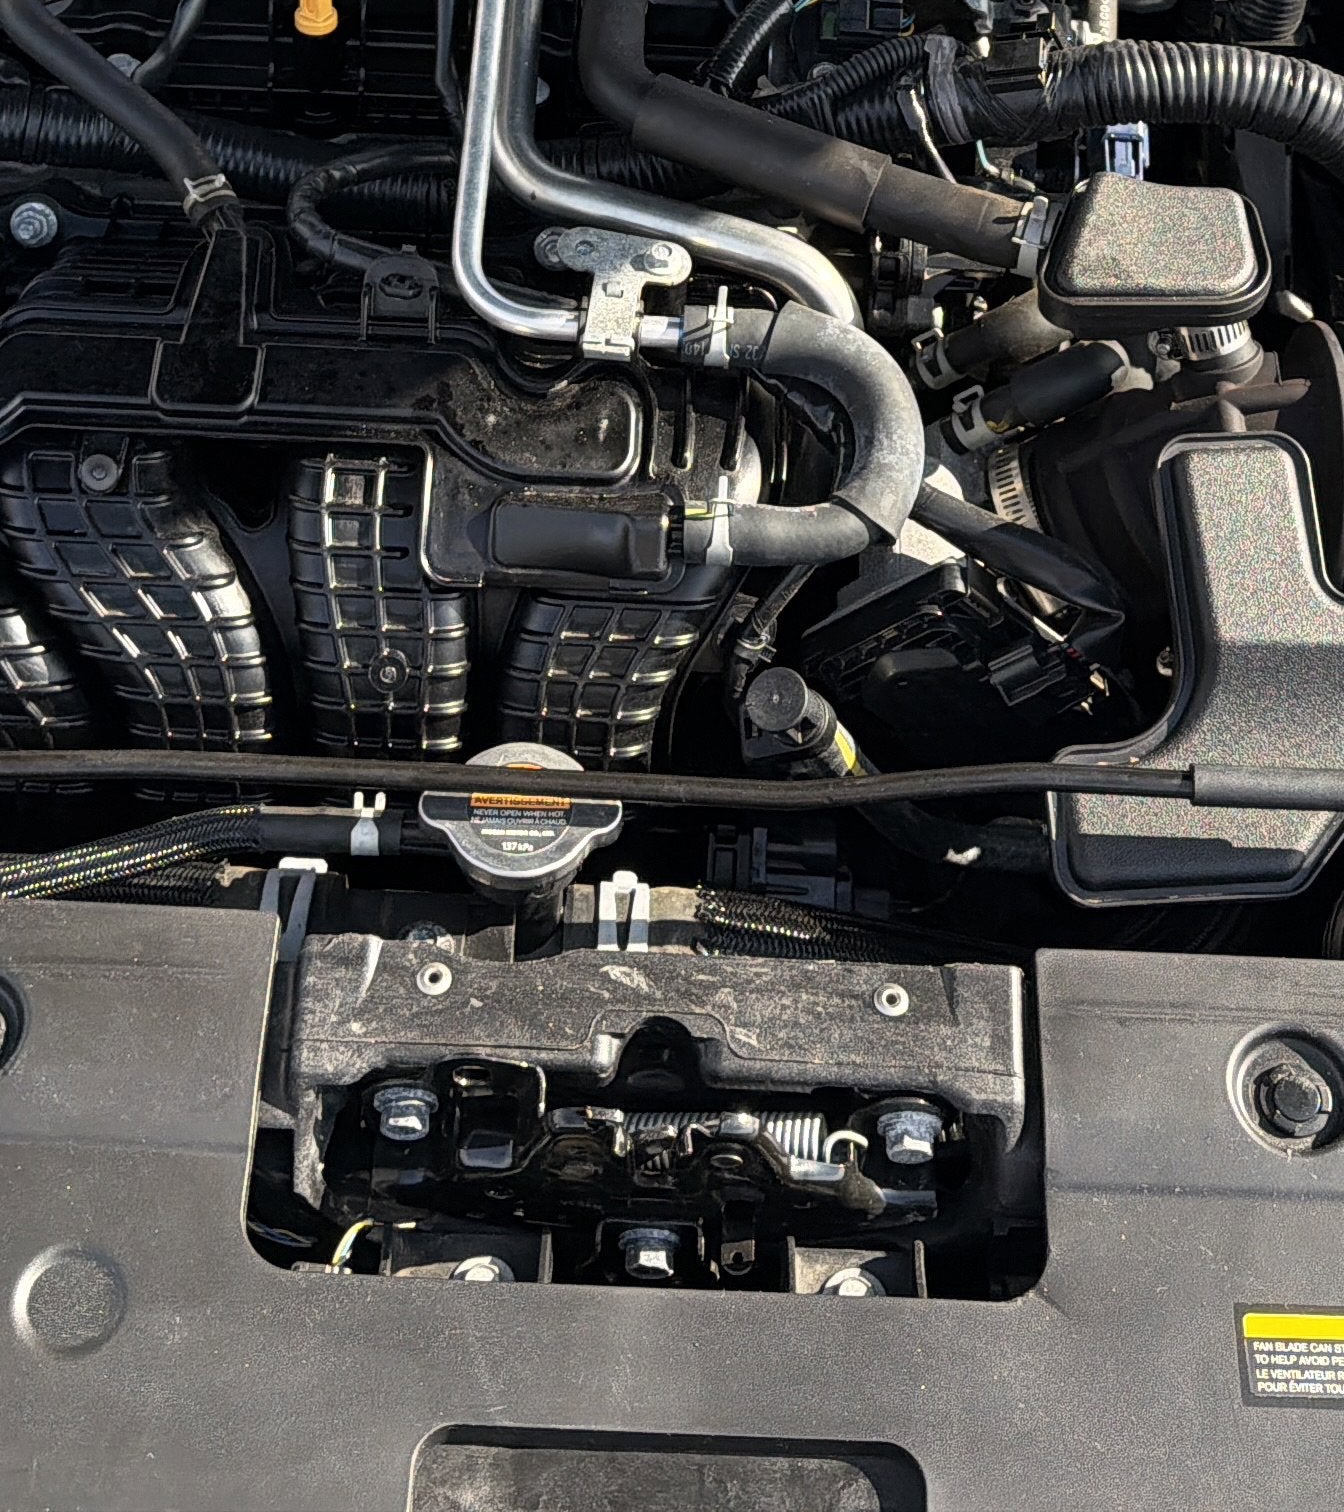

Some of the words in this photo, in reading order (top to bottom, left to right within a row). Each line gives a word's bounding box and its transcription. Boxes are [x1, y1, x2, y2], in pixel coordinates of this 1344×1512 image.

[474, 796, 565, 806] AVERTISSEMENT
[473, 808, 499, 816] NEVER
[500, 809, 521, 817] OPEN
[1253, 1341, 1273, 1351] FAN
[1275, 1342, 1308, 1352] BLADE
[1309, 1343, 1332, 1353] CAN
[1254, 1354, 1269, 1364] TO
[1270, 1355, 1297, 1365] HELP
[1299, 1355, 1330, 1366] AVOID
[1256, 1368, 1269, 1379] LE
[1270, 1369, 1336, 1380] VENTILATEUR
[1258, 1381, 1287, 1392] POUR
[1288, 1380, 1324, 1393] ÉVITER
